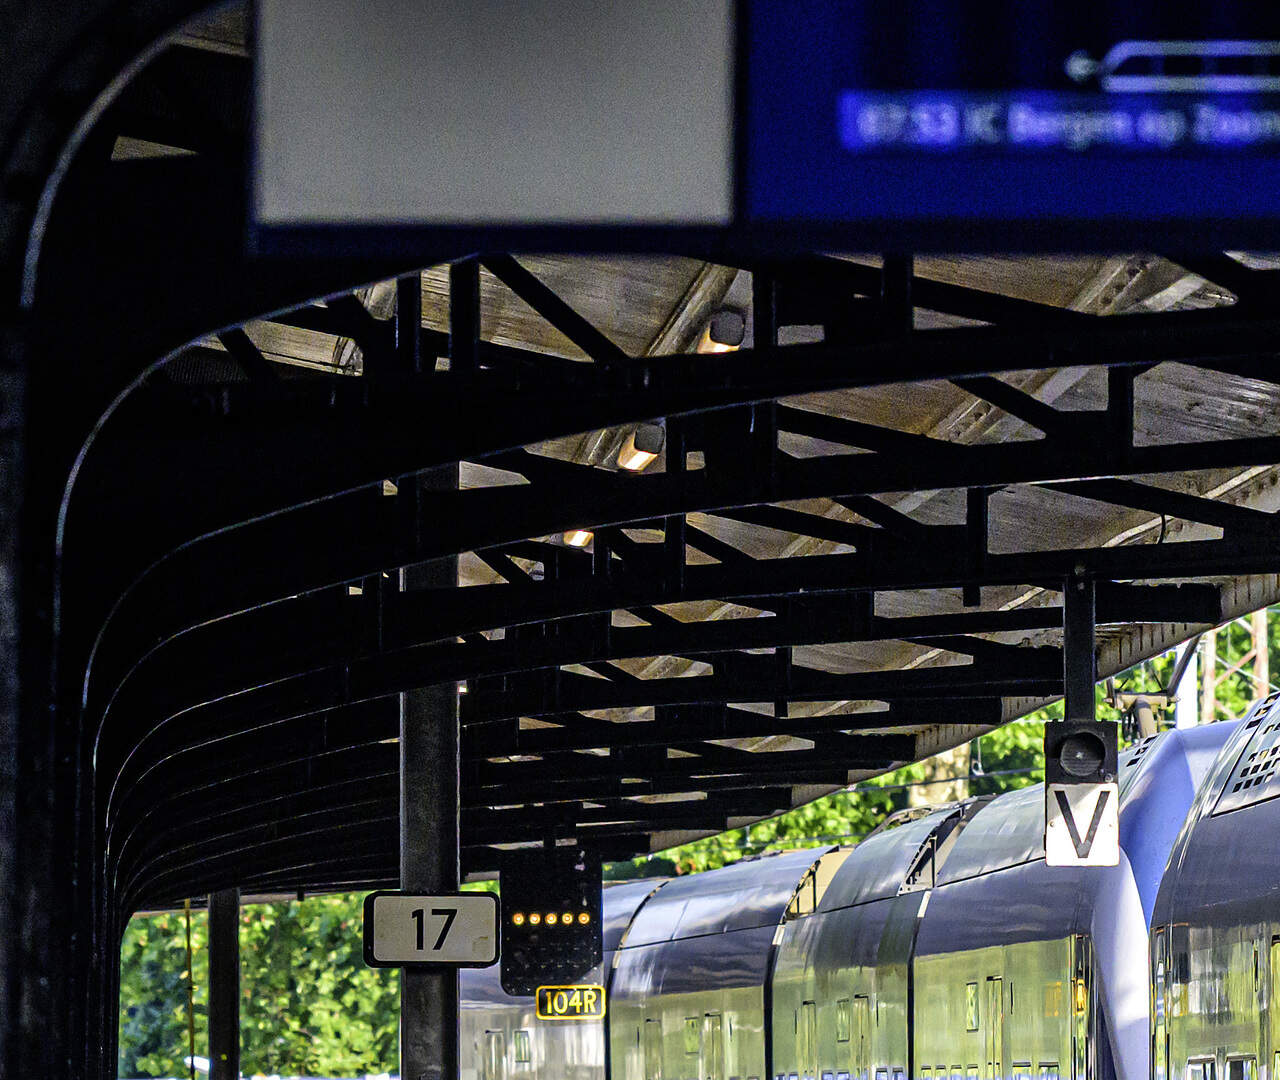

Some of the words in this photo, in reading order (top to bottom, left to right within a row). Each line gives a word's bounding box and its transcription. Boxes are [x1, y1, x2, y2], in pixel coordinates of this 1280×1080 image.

[1055, 790, 1110, 858] V
[411, 908, 458, 951] 17
[546, 990, 597, 1014] 104R
